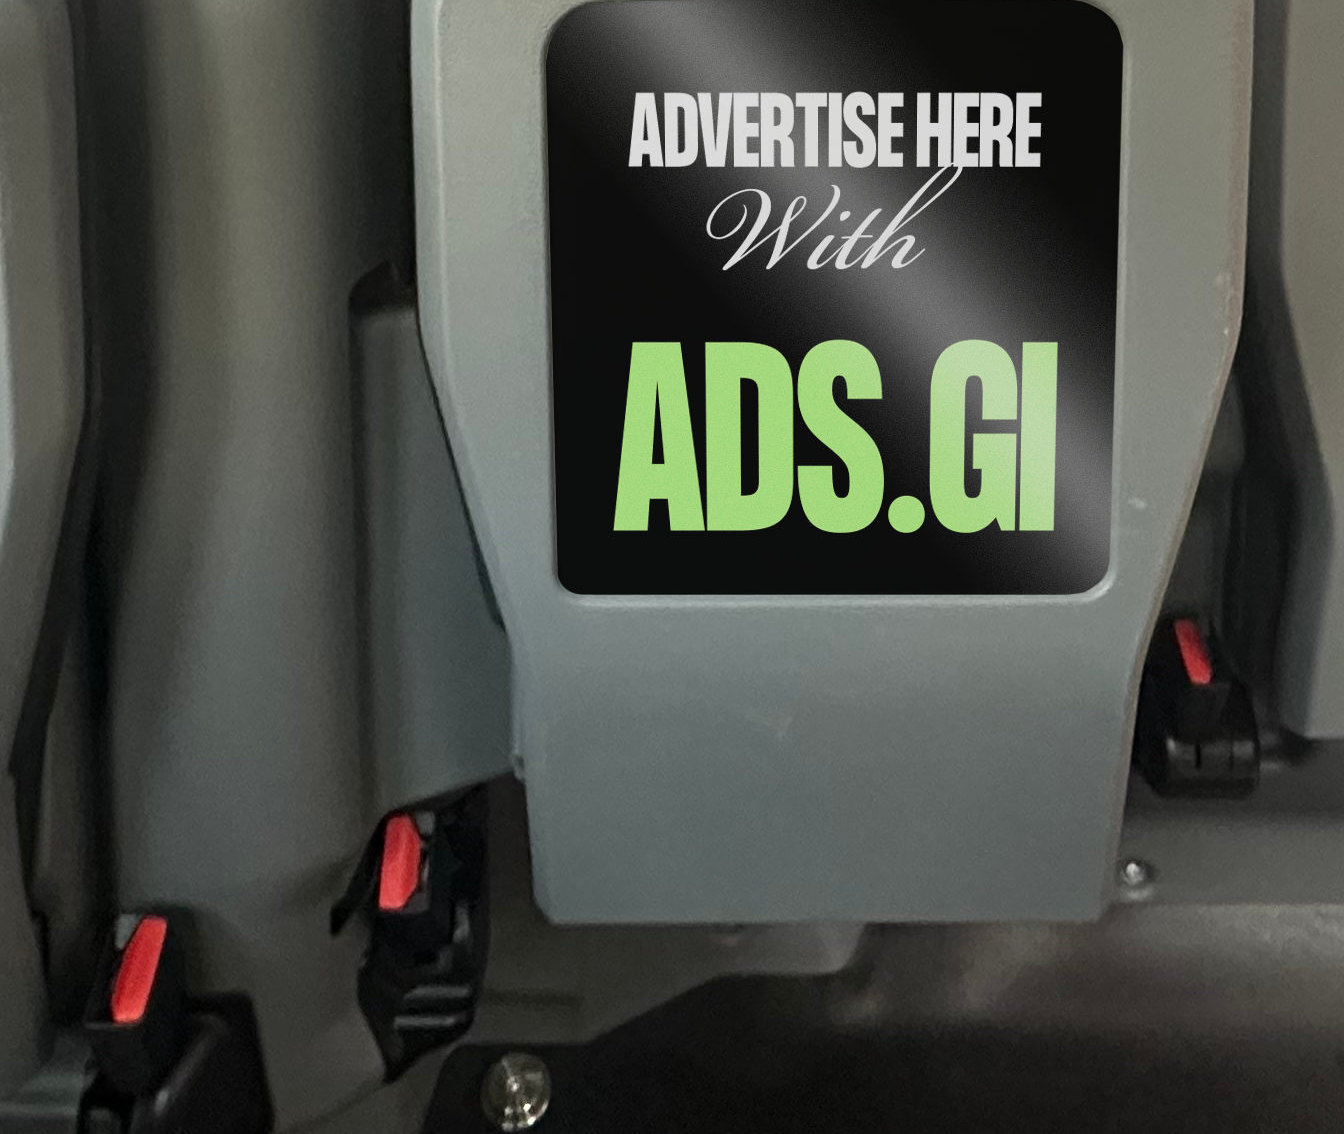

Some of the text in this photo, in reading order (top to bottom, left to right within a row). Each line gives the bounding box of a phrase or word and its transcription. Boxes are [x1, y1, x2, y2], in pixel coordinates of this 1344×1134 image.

[628, 91, 1043, 169] ADVERTISE HERE
[705, 160, 964, 272] With
[612, 339, 1060, 534] ADS.GI
